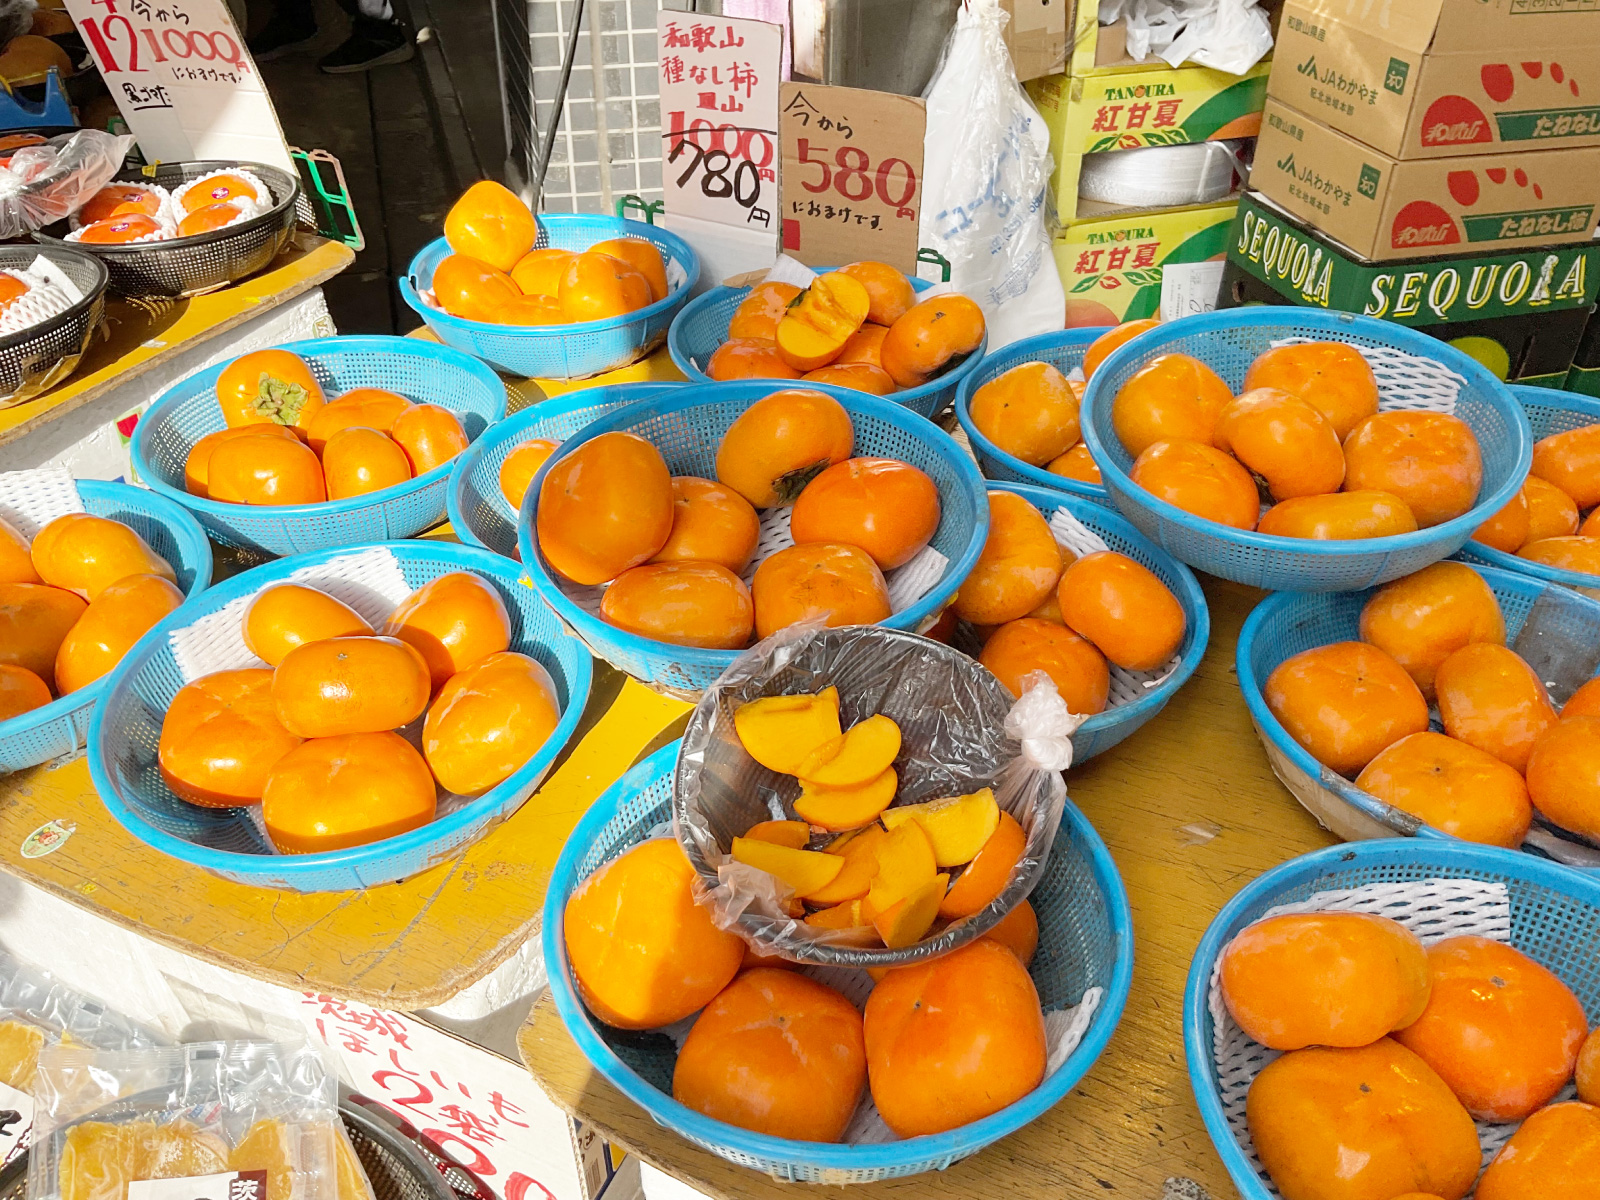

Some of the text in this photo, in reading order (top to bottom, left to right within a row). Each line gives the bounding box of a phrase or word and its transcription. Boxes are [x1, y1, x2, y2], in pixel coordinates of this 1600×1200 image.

[140, 28, 250, 74] 1000円
[662, 22, 744, 53] 和歌山
[661, 55, 758, 98] 種なし柿
[1320, 67, 1378, 105] JAわかやま
[783, 91, 853, 139] 今から
[1091, 99, 1183, 132] 紅甘夏
[668, 139, 770, 228] 780円
[797, 138, 916, 221] 580円
[1298, 166, 1352, 207] JAわかやま
[1073, 242, 1161, 274] 紅甘夏
[1238, 210, 1334, 308] SEQUOIA
[1364, 253, 1587, 320] SEQUOIA
